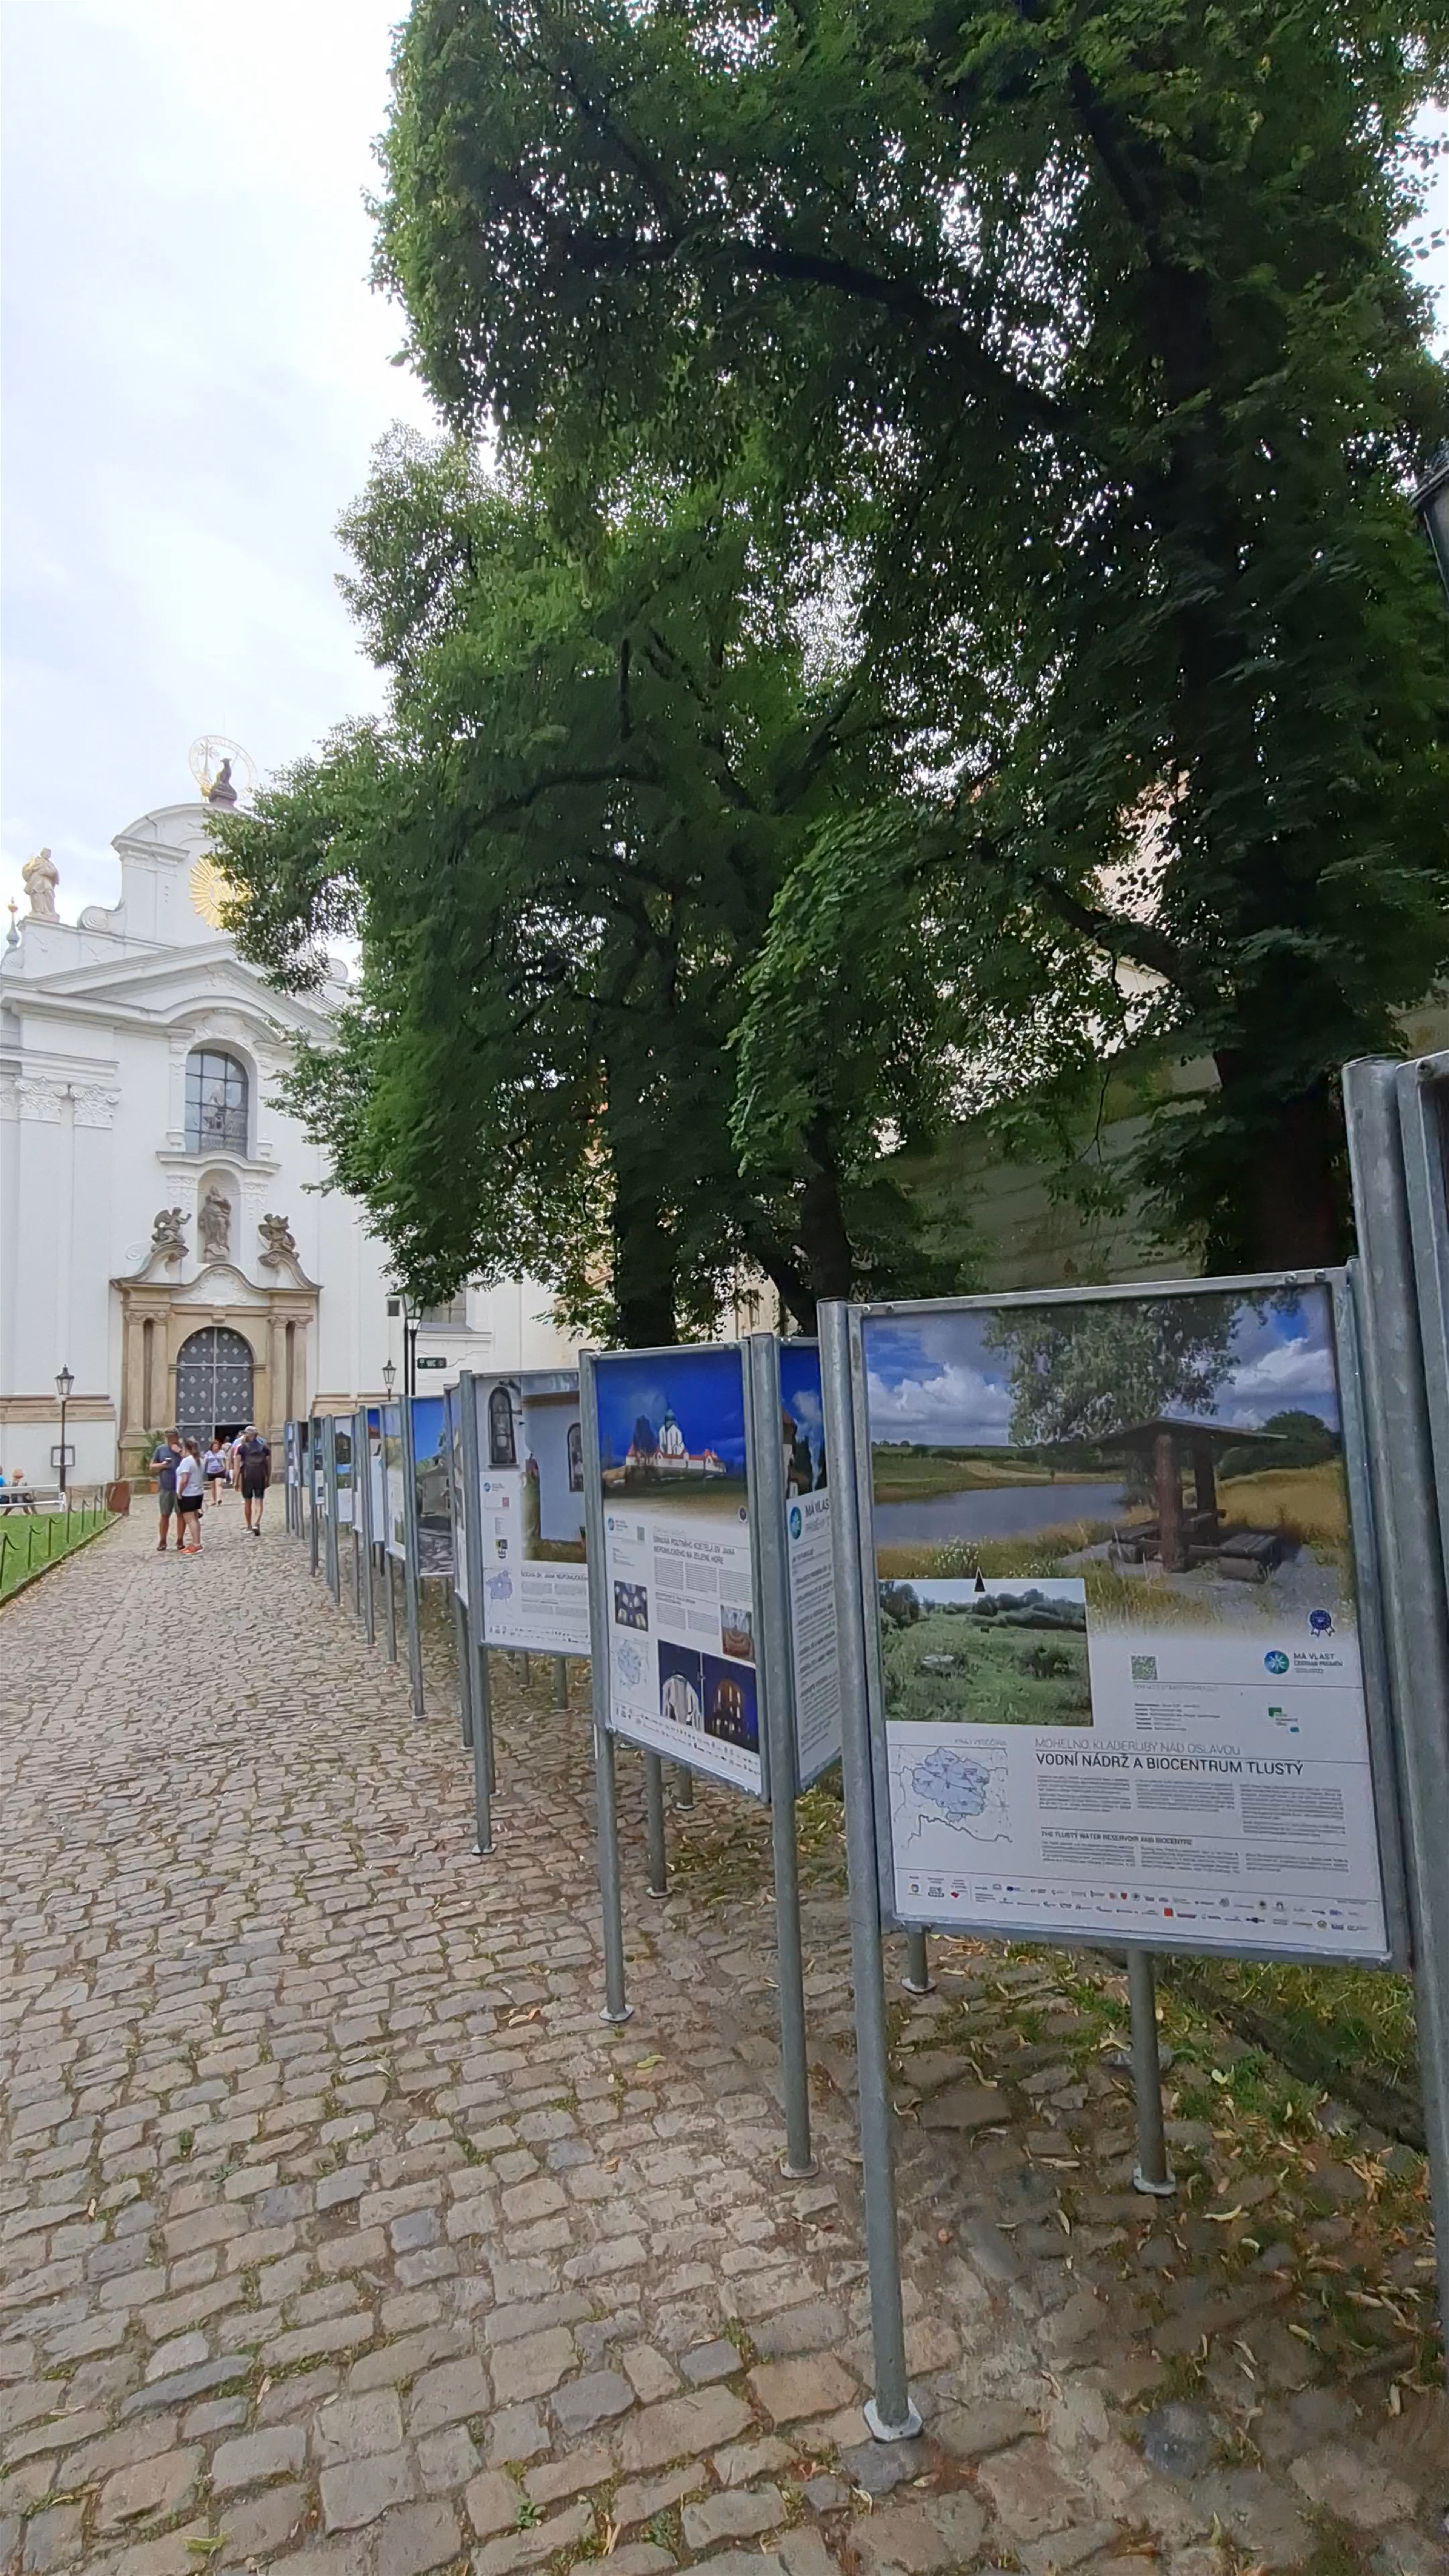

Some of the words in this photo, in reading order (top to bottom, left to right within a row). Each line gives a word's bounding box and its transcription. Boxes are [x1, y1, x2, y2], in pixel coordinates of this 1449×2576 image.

[1093, 1740, 1158, 1752] KLADERUBY
[1160, 1742, 1184, 1753] NAD
[1187, 1744, 1240, 1755] OSLAVOU
[1036, 1752, 1078, 1766] VODNÍ
[1082, 1752, 1129, 1768] NÁDRŽ
[1133, 1757, 1143, 1769] A
[1146, 1758, 1242, 1773] BIOCENTRUM
[1244, 1760, 1304, 1775] TLUSTÝ
